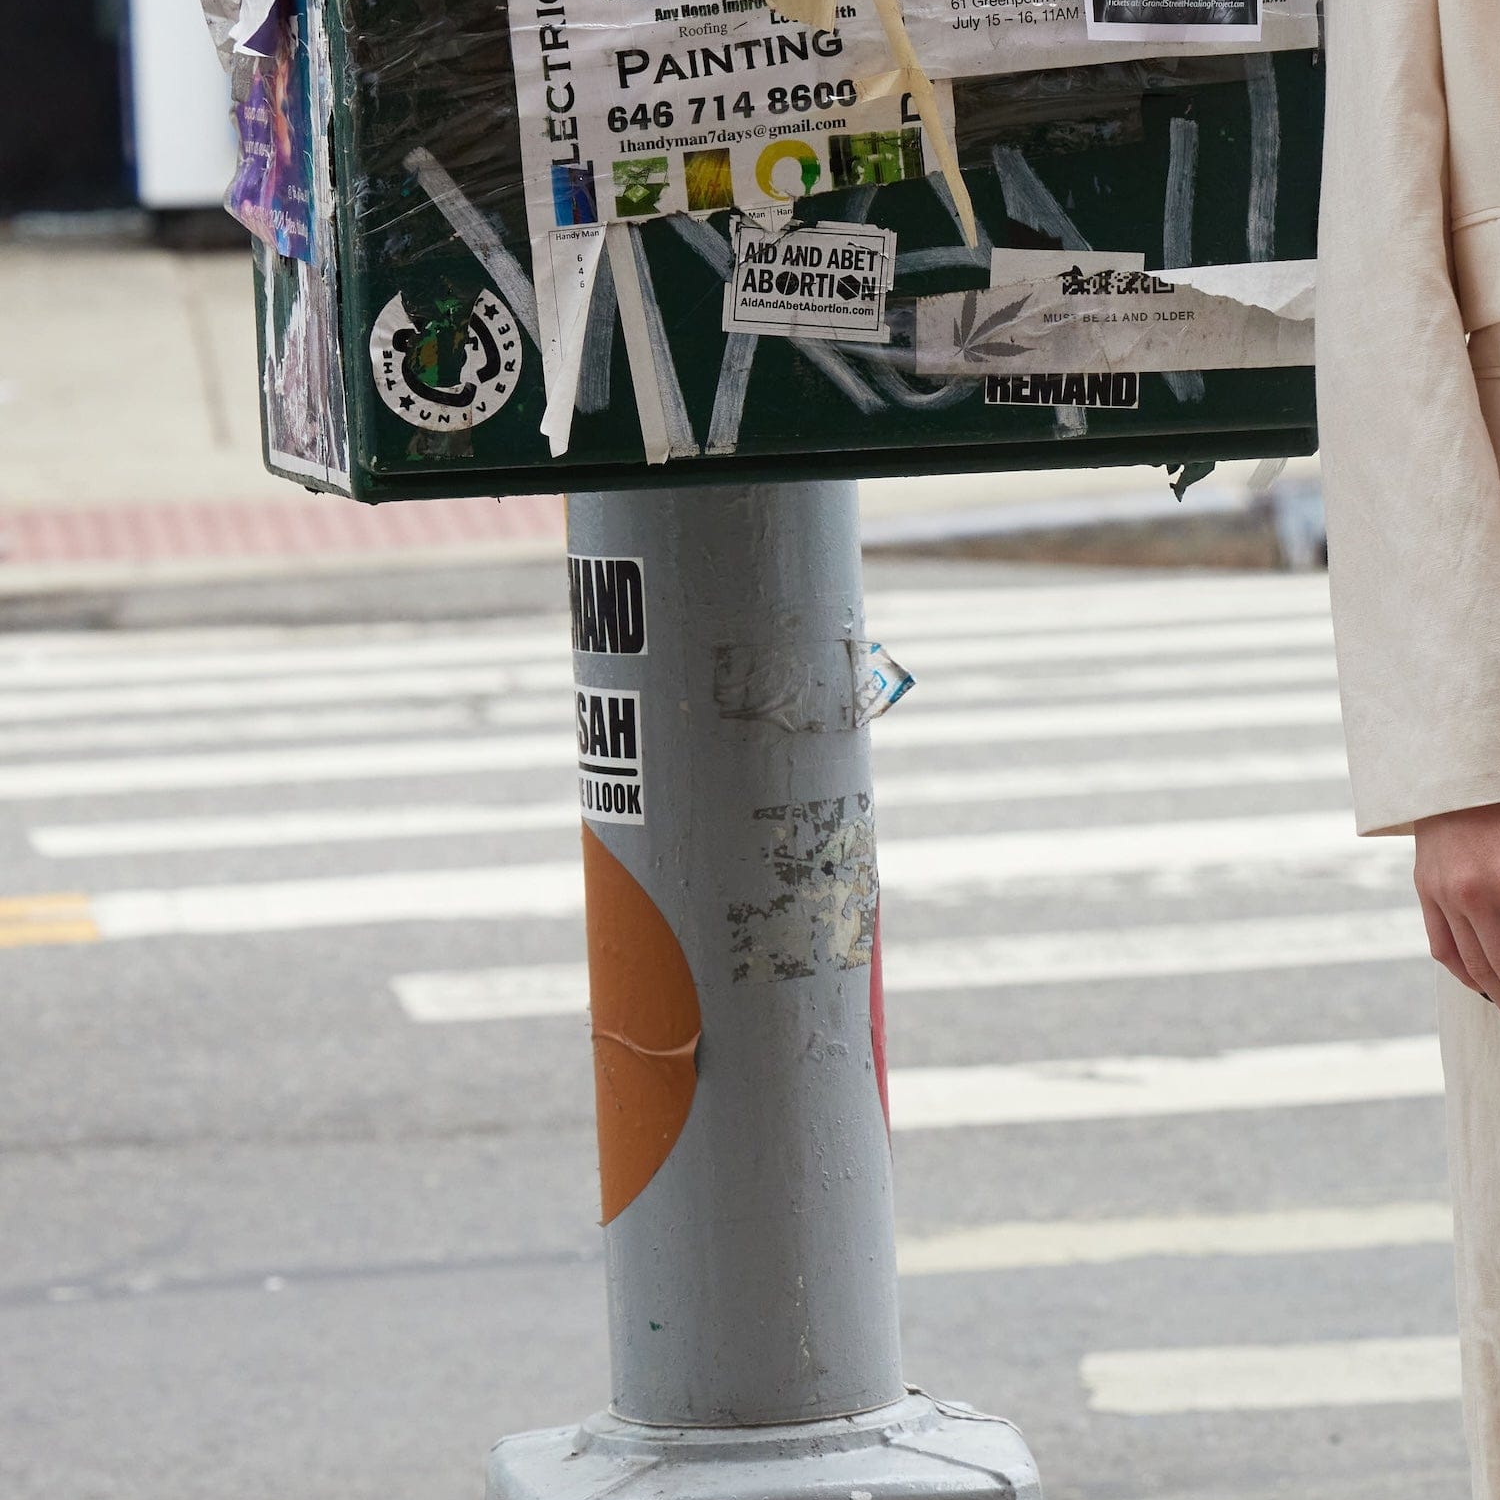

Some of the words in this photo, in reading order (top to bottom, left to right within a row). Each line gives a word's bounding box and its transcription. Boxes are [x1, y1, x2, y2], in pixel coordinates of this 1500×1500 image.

[655, 7, 679, 22] Any
[681, 2, 720, 18] Home
[952, 14, 981, 31] July
[984, 12, 1002, 27] 15
[1016, 10, 1038, 27] 16,
[1041, 7, 1080, 24] 11AM
[679, 21, 728, 39] Roofing
[607, 100, 674, 133] 646
[688, 91, 755, 125] 714
[767, 79, 857, 114] 8600
[619, 117, 847, 153] 1handyman7days@gmail.com
[555, 231, 579, 242] Handy
[581, 228, 600, 239] Man
[576, 253, 584, 263] 6
[744, 241, 778, 266] AID
[782, 244, 822, 269] AND
[826, 247, 879, 272] ABET
[578, 266, 584, 275] 4
[579, 280, 586, 289] 6
[741, 268, 877, 303] ABORTION
[740, 297, 875, 317] AidAndAbetAbortion.com
[1082, 313, 1100, 323] BE
[1104, 312, 1117, 323] 21
[1122, 311, 1148, 323] AND
[1153, 310, 1195, 322] OLDER
[382, 350, 398, 391] THE
[985, 371, 1138, 407] REMAND
[568, 557, 646, 655] MAND
[574, 694, 638, 760] SAH
[595, 782, 643, 815] LOOK
